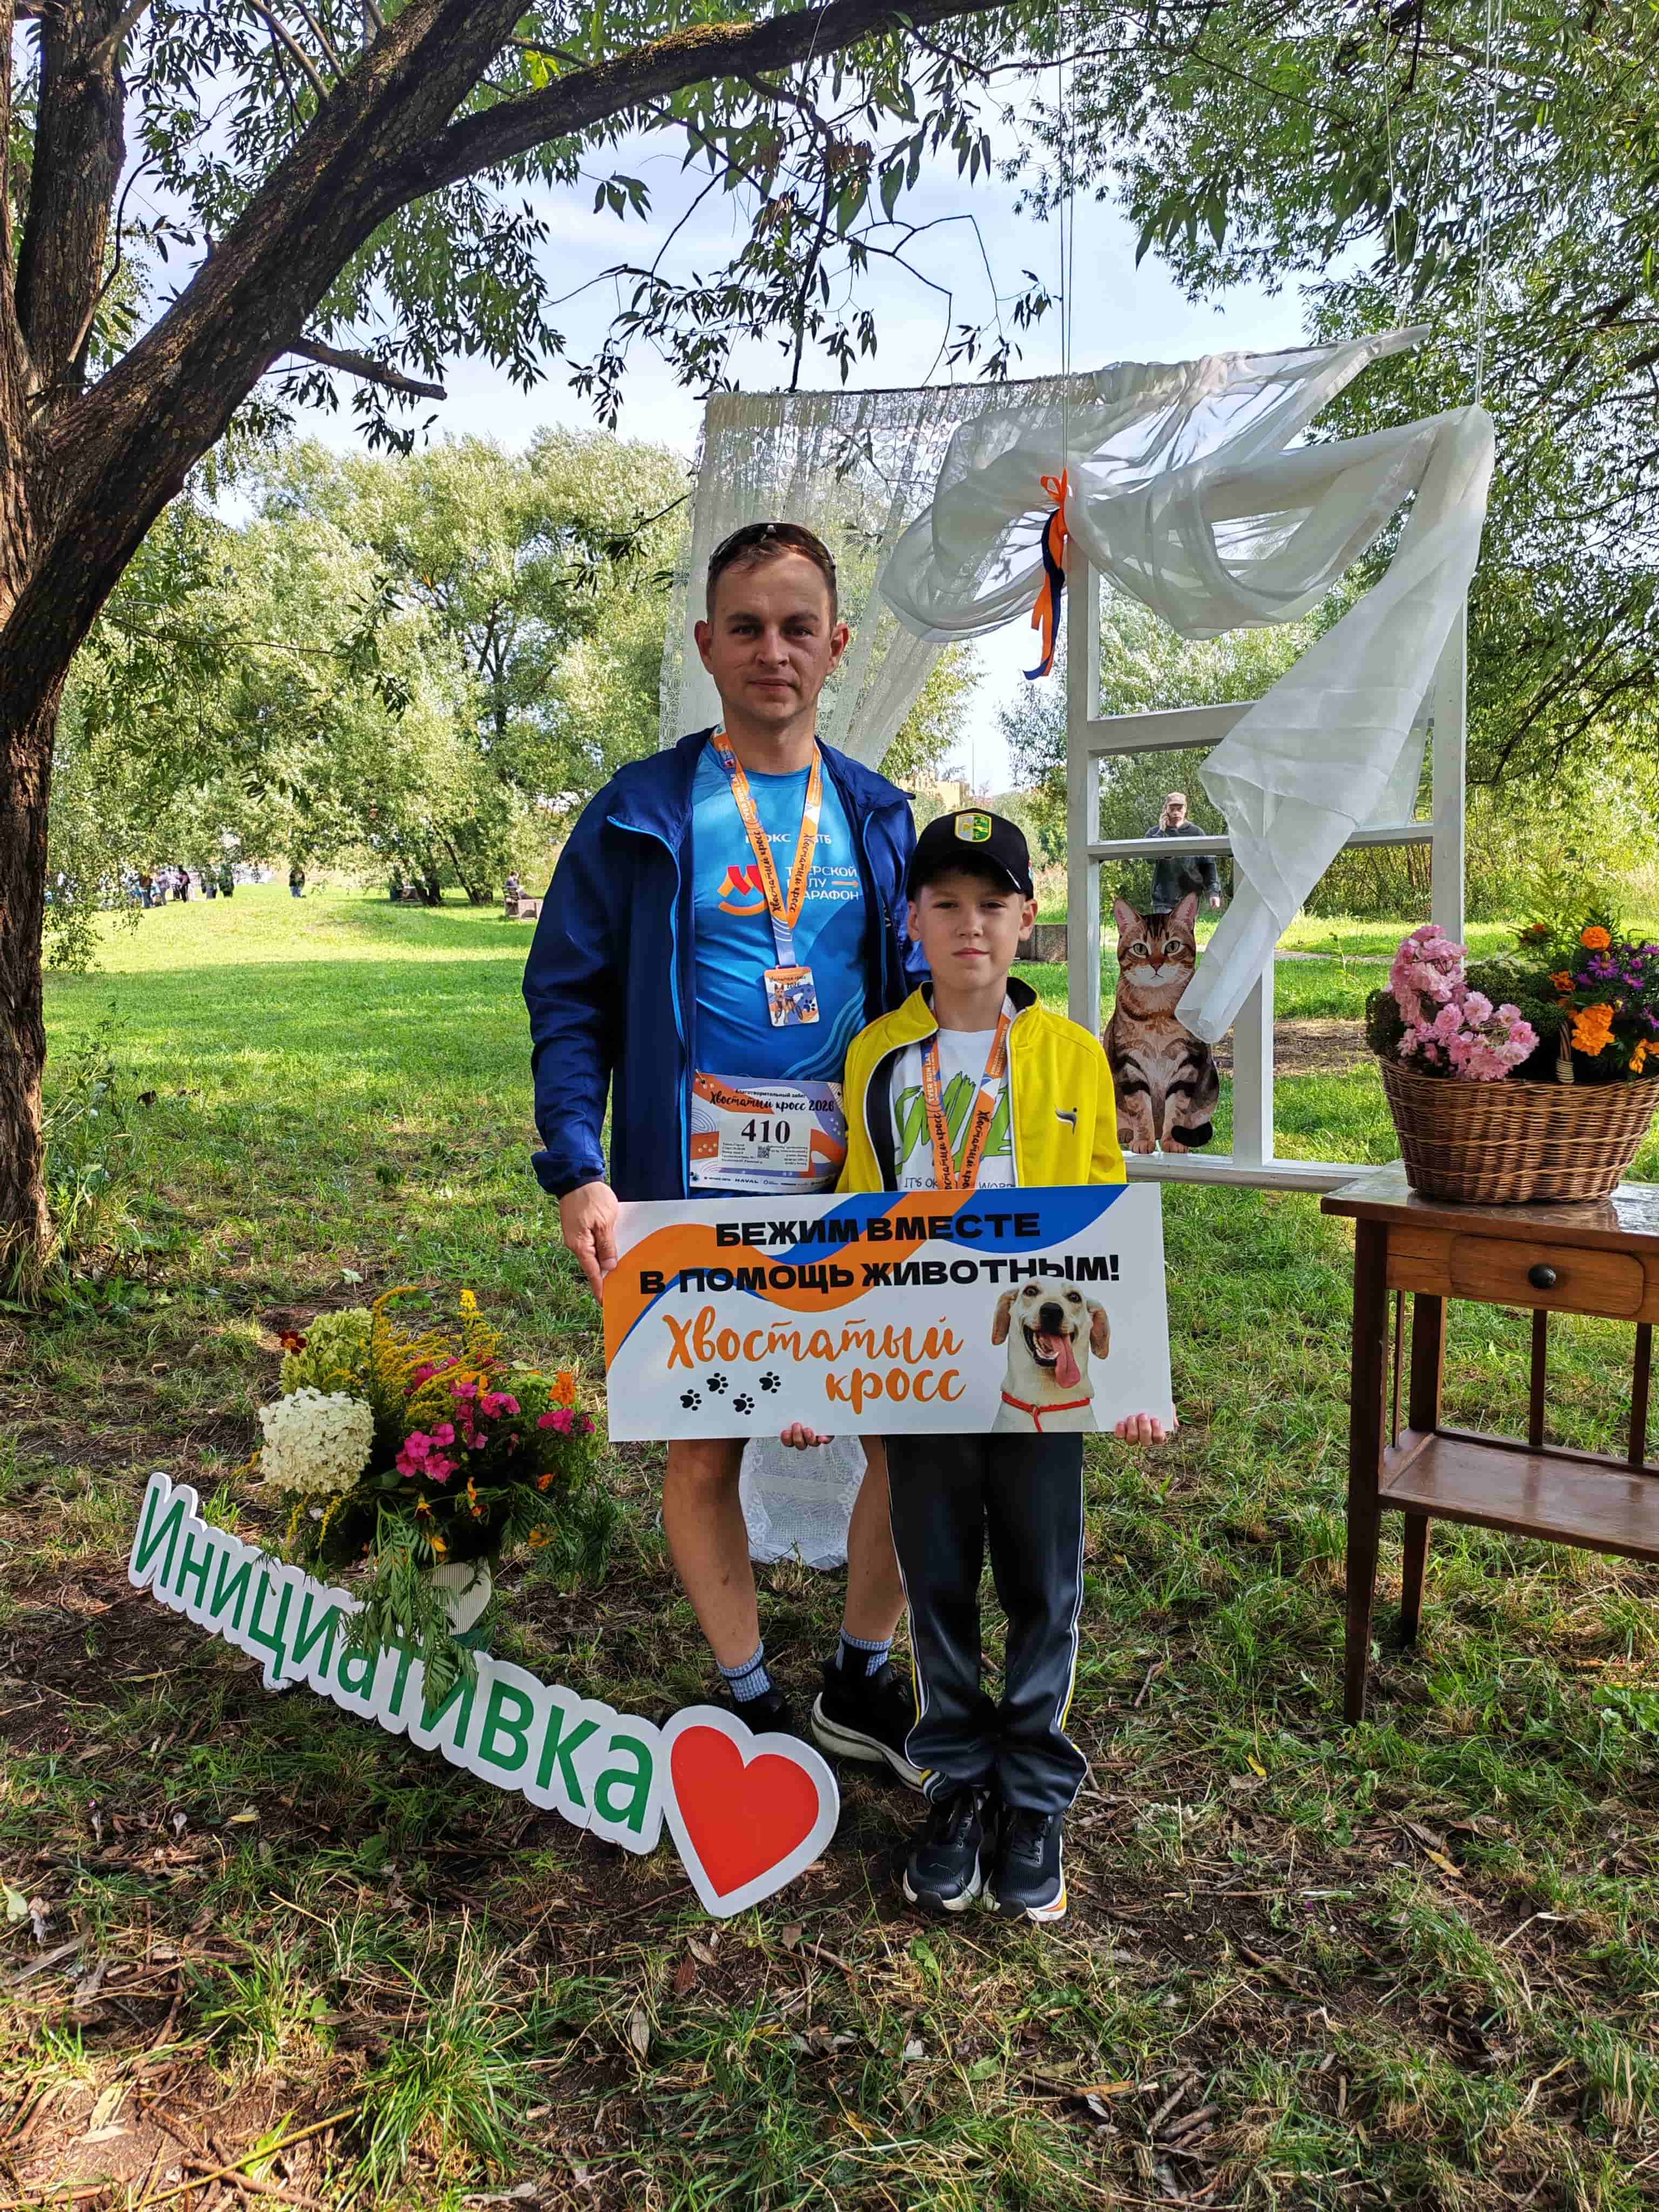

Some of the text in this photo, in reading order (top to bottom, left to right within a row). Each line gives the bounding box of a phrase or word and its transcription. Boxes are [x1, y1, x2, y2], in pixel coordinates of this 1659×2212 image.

[753, 831, 767, 855] кросс
[785, 865, 857, 877] ТРСКОЙ
[787, 878, 826, 888] ЛУ
[790, 887, 800, 913] кросс
[804, 890, 859, 900] АРАФОН
[709, 1091, 835, 1112] Хвостатый кросс 2026
[741, 1118, 791, 1144] 410
[939, 1142, 952, 1189] остатый
[962, 1170, 973, 1188] кро
[716, 1212, 1041, 1247] БЕЖИМ ВМЕСТЕ
[640, 1255, 1120, 1294] В ПОМОЩЬ ЖИВОТНЫМ!
[662, 1306, 964, 1369] Хвостатый
[826, 1367, 966, 1414] кросс
